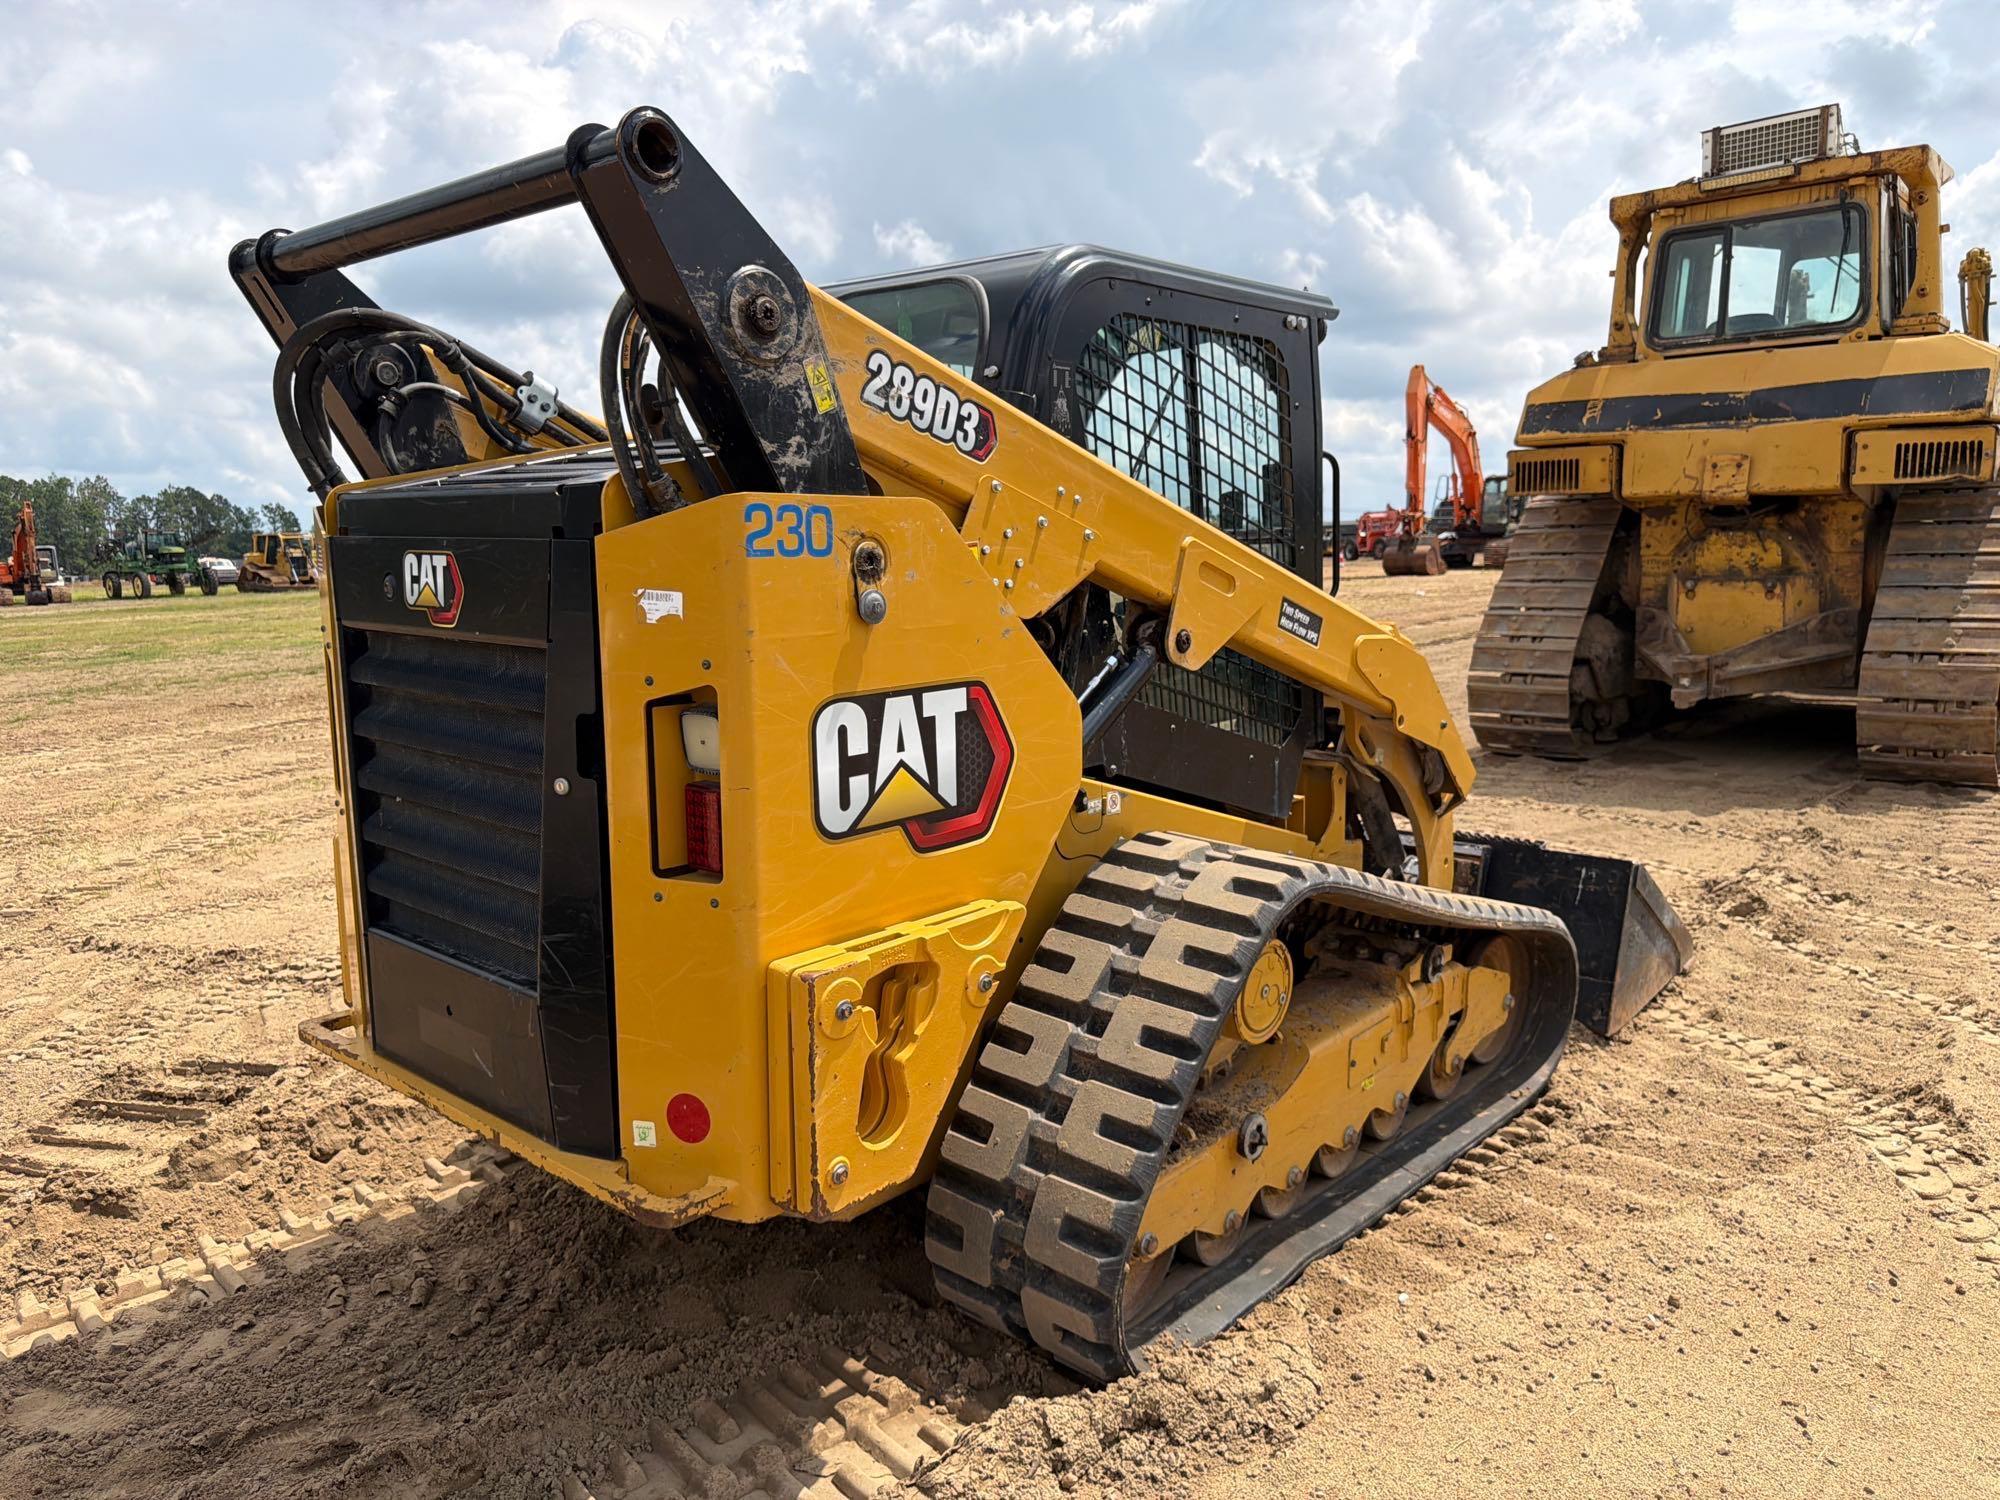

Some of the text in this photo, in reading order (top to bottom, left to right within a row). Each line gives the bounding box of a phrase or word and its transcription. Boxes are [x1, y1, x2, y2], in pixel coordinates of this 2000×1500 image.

[863, 352, 980, 451] 289D3
[744, 503, 833, 557] 230
[404, 553, 448, 607] CAT
[815, 687, 968, 834] CAT
